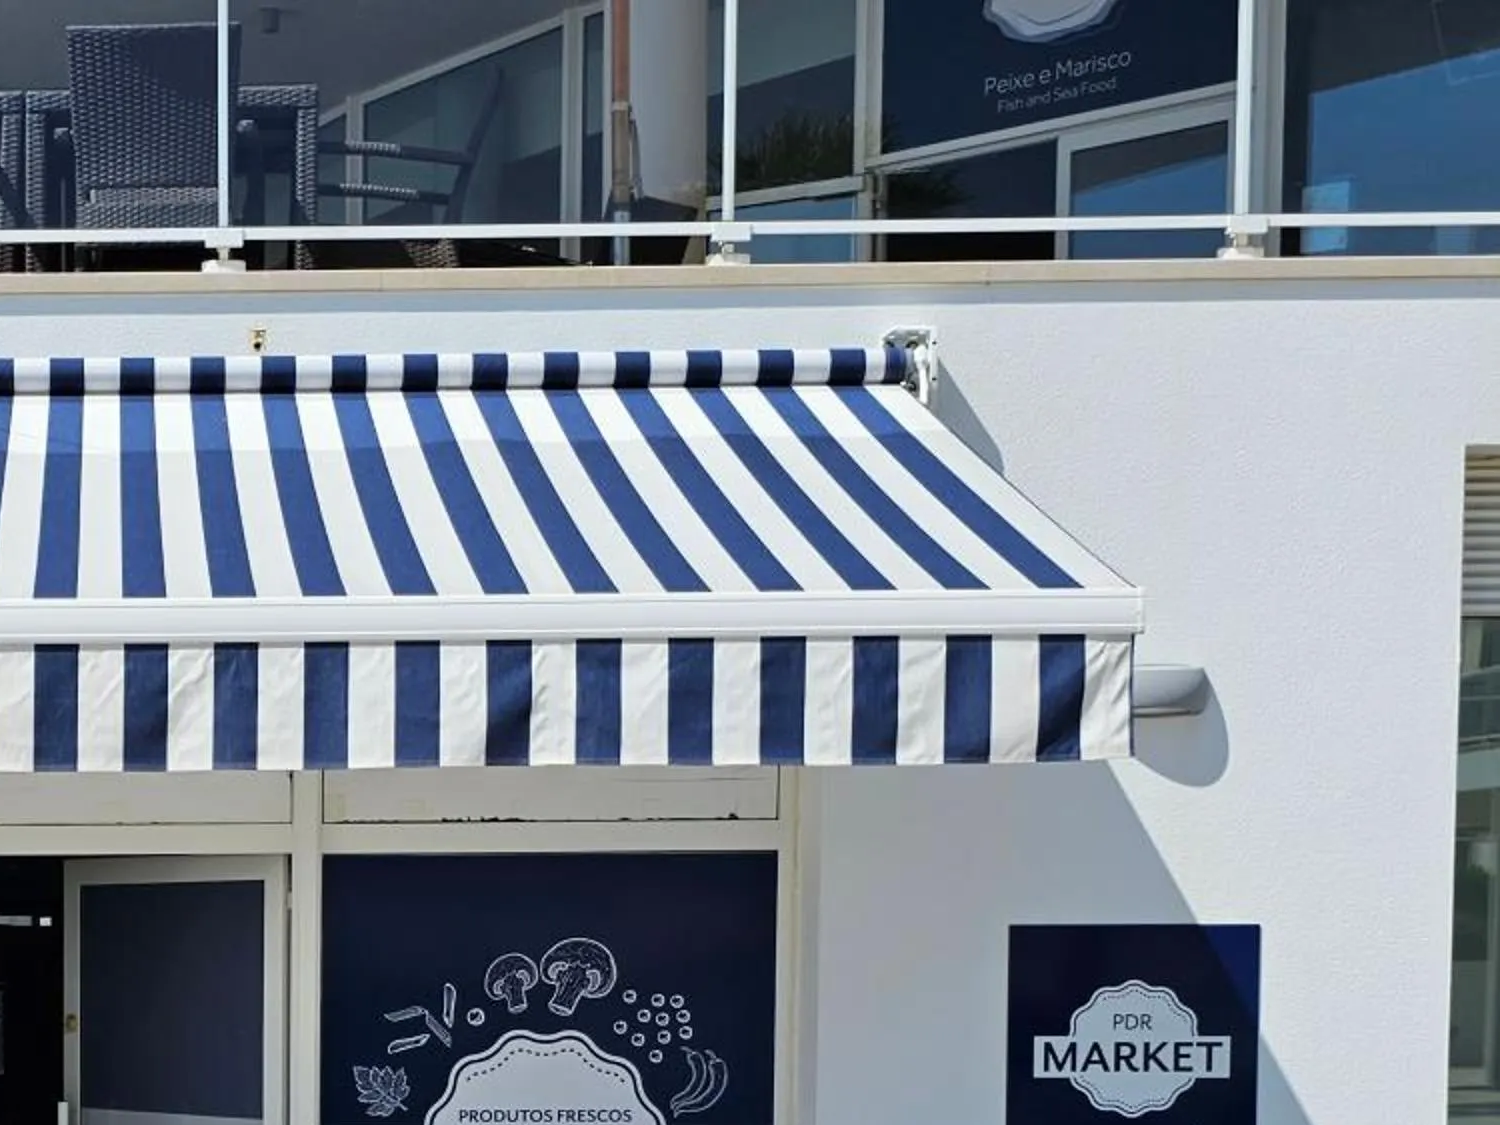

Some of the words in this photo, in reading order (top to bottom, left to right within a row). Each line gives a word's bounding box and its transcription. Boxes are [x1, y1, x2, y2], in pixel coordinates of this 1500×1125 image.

[984, 72, 1035, 96] Peixe
[1039, 68, 1051, 85] e
[1055, 51, 1132, 80] Marisco
[1026, 91, 1050, 107] and
[1053, 85, 1078, 102] Sea
[1081, 76, 1117, 95] Food
[1113, 1013, 1153, 1031] PDR
[1043, 1041, 1223, 1073] MARKET
[458, 1109, 553, 1123] PRODUTOS
[557, 1109, 633, 1123] FRESCOS
